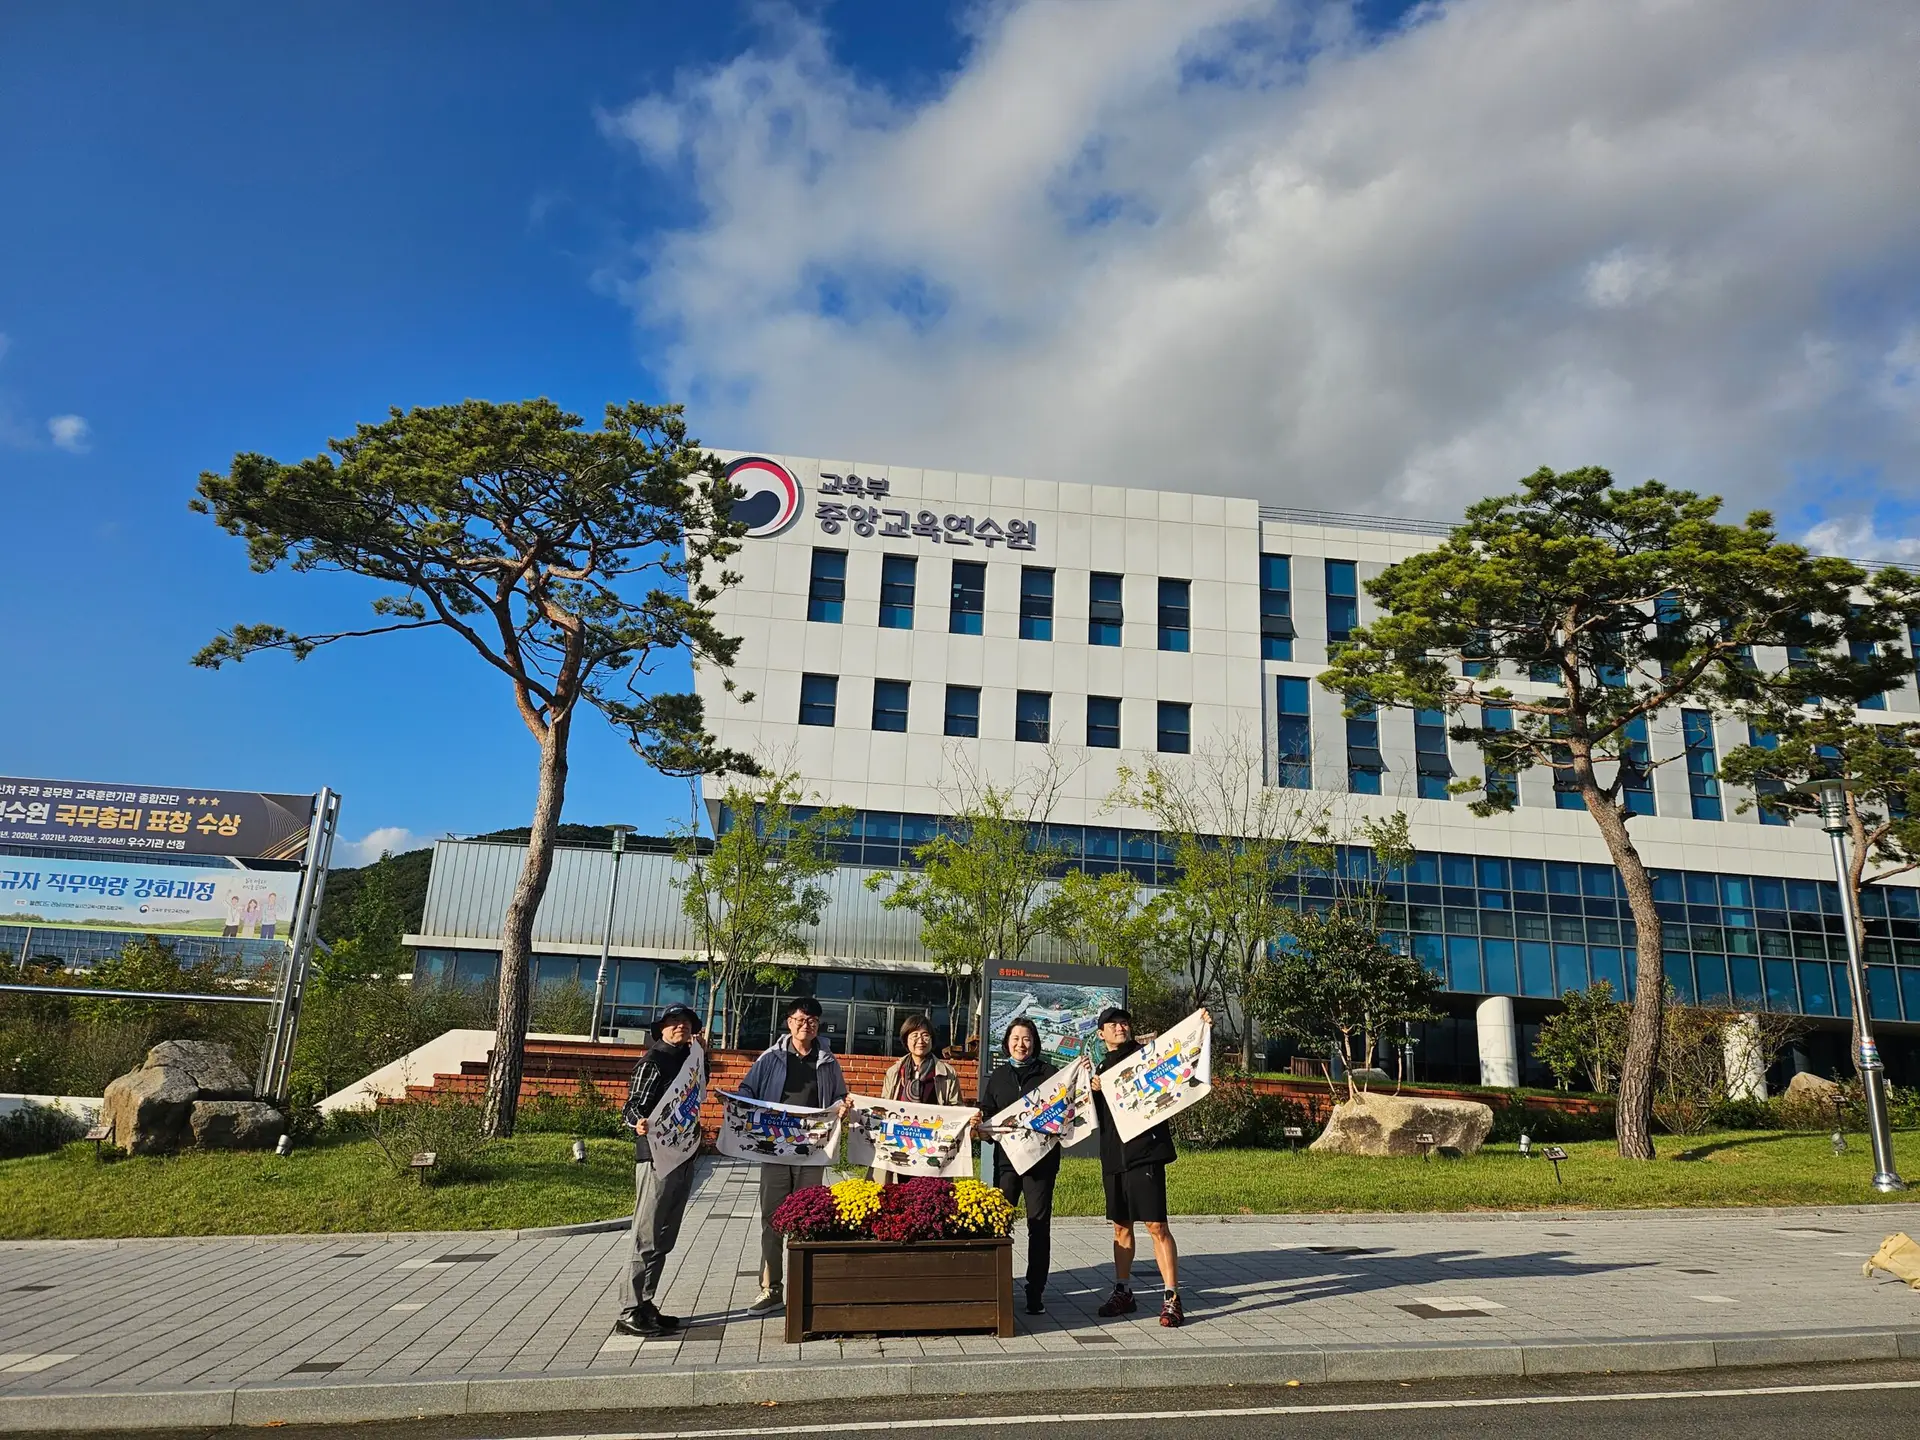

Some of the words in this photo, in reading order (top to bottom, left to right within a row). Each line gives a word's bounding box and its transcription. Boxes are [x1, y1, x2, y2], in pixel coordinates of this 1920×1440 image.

[818, 472, 890, 499] 교육부
[816, 501, 1036, 551] 중앙교육연수원
[18, 785, 40, 797] 주관
[42, 787, 73, 799] 공무원
[75, 789, 136, 803] 교육훈련기관
[139, 793, 180, 805] 종합진단
[55, 804, 142, 831] 국무총리
[146, 810, 192, 834] 표창
[196, 812, 242, 836] 수상
[127, 837, 164, 849] 우수기관
[166, 840, 185, 850] 선정
[0, 870, 41, 891] 규자
[46, 873, 130, 896] 직무역량
[134, 878, 216, 902] 강화과정
[1037, 1107, 1055, 1121] WALK
[896, 1129, 926, 1138] TOGETHER
